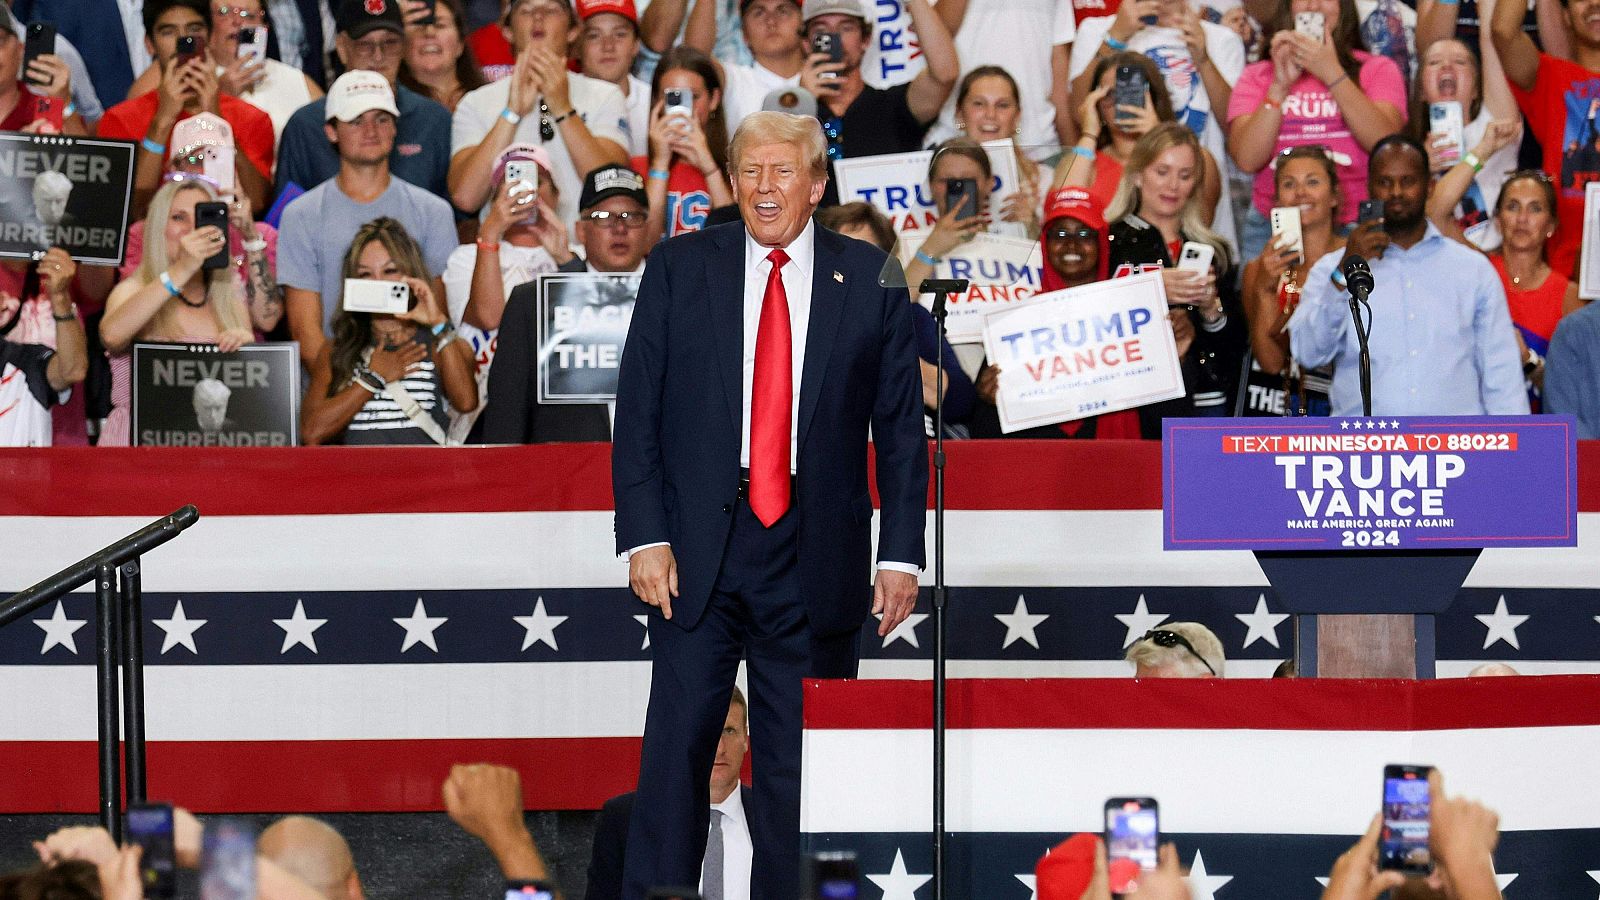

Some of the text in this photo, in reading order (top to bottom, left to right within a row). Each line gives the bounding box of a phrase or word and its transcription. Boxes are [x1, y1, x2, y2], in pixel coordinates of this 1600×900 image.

[877, 0, 904, 79] TRU
[0, 222, 117, 249] RRENDER
[930, 257, 1043, 285] RUM
[1001, 308, 1152, 360] TRUMP
[554, 343, 619, 369] THE
[1024, 339, 1144, 382] VANCE
[152, 359, 270, 388] NEVER
[1248, 384, 1286, 415] THE
[141, 429, 286, 446] SURRENDER
[1231, 434, 1510, 452] TEXT MINNESOTA TO 88022
[1275, 454, 1466, 489] TRUMP
[1296, 489, 1444, 518] VANCE
[1287, 518, 1455, 529] MAKE AMERICA GREAT AGAIN!
[1341, 530, 1400, 547] 2024
